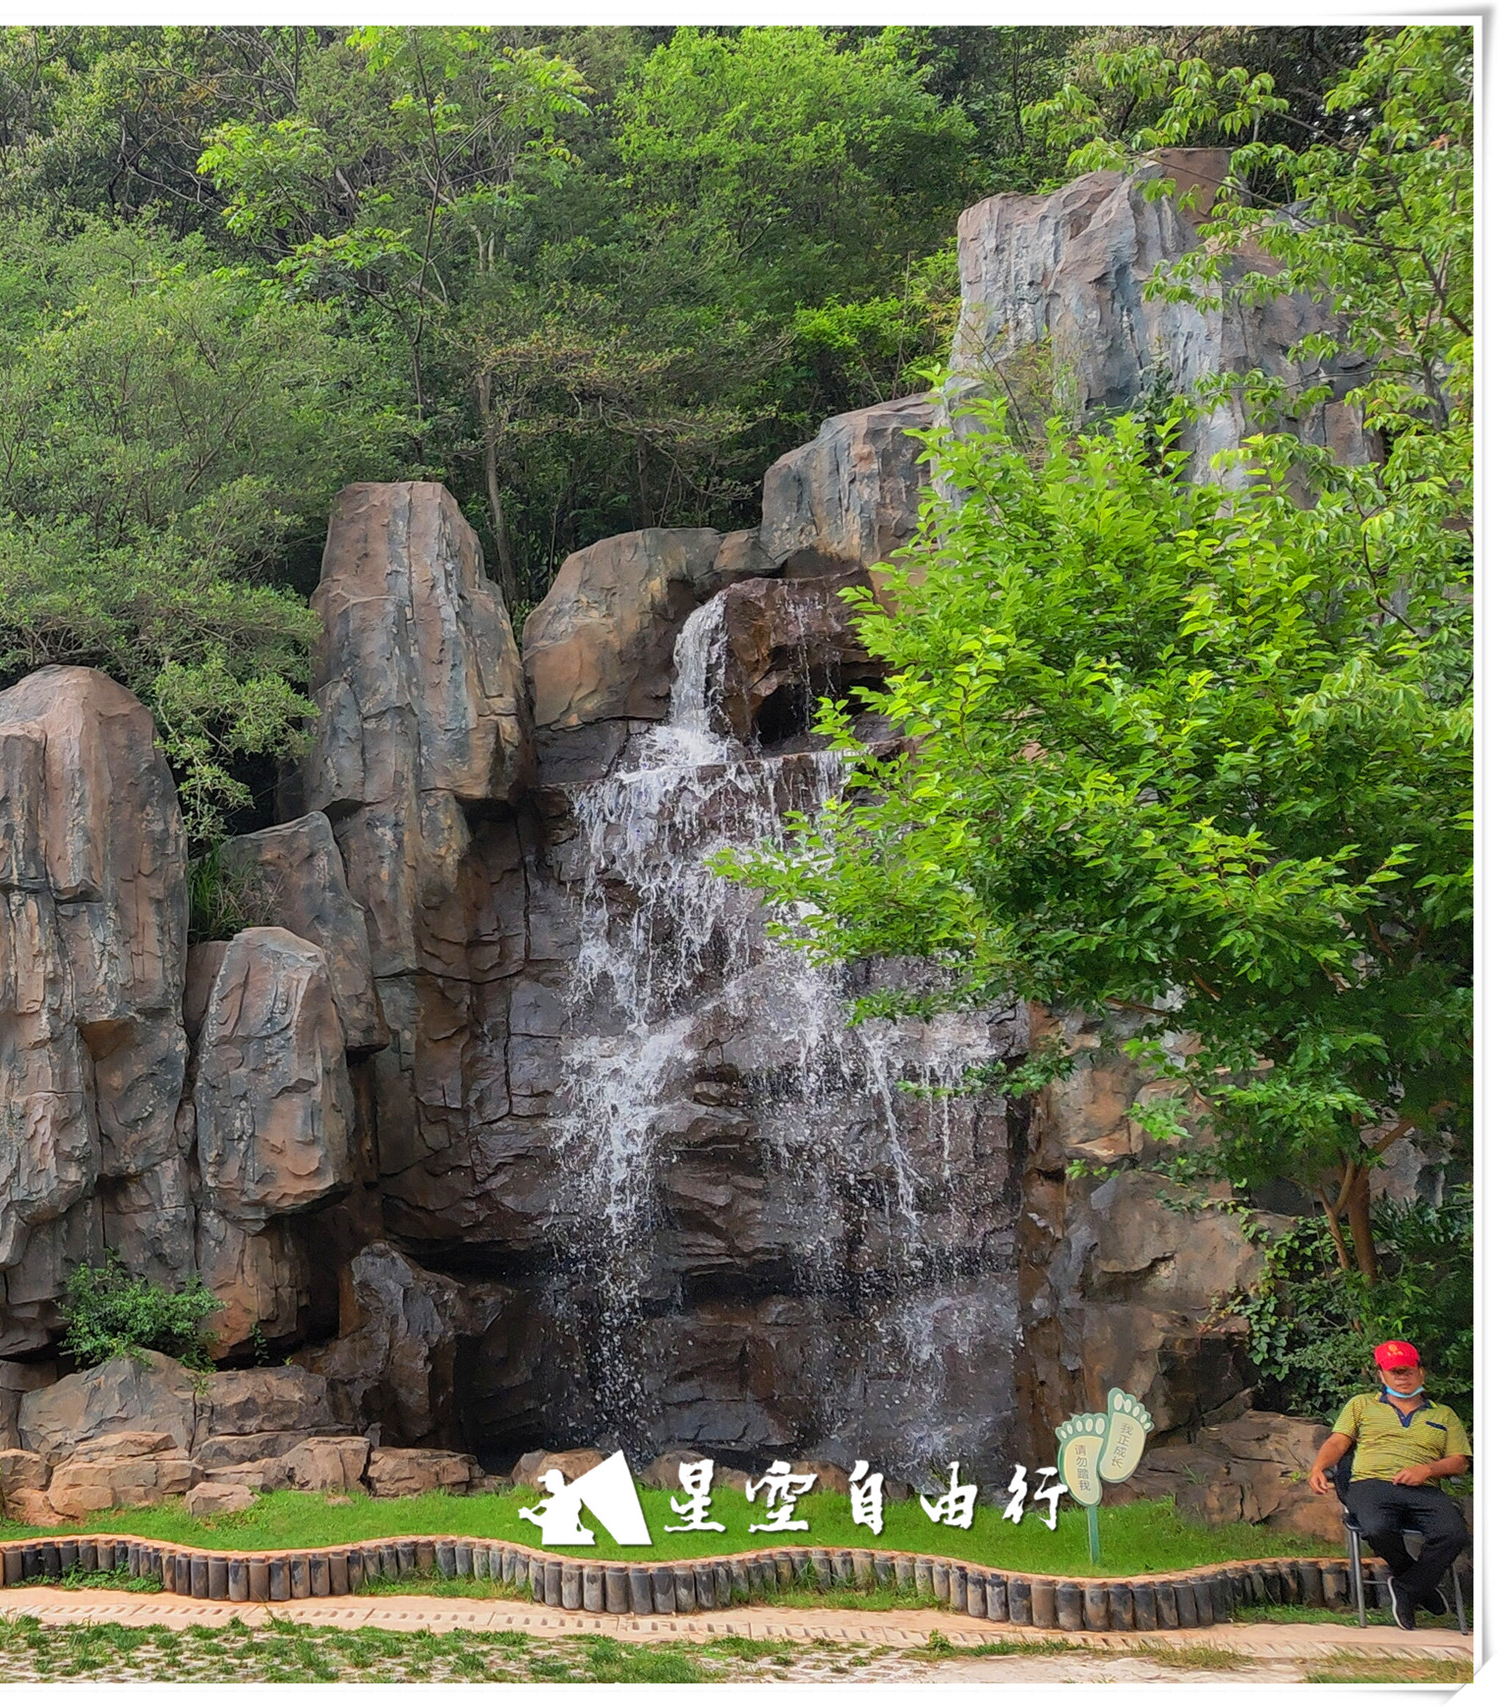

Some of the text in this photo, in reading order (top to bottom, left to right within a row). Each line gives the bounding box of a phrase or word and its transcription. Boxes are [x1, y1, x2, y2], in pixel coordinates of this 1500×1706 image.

[1074, 1444, 1092, 1492] 请勿踏我
[1111, 1422, 1134, 1470] 我正成长
